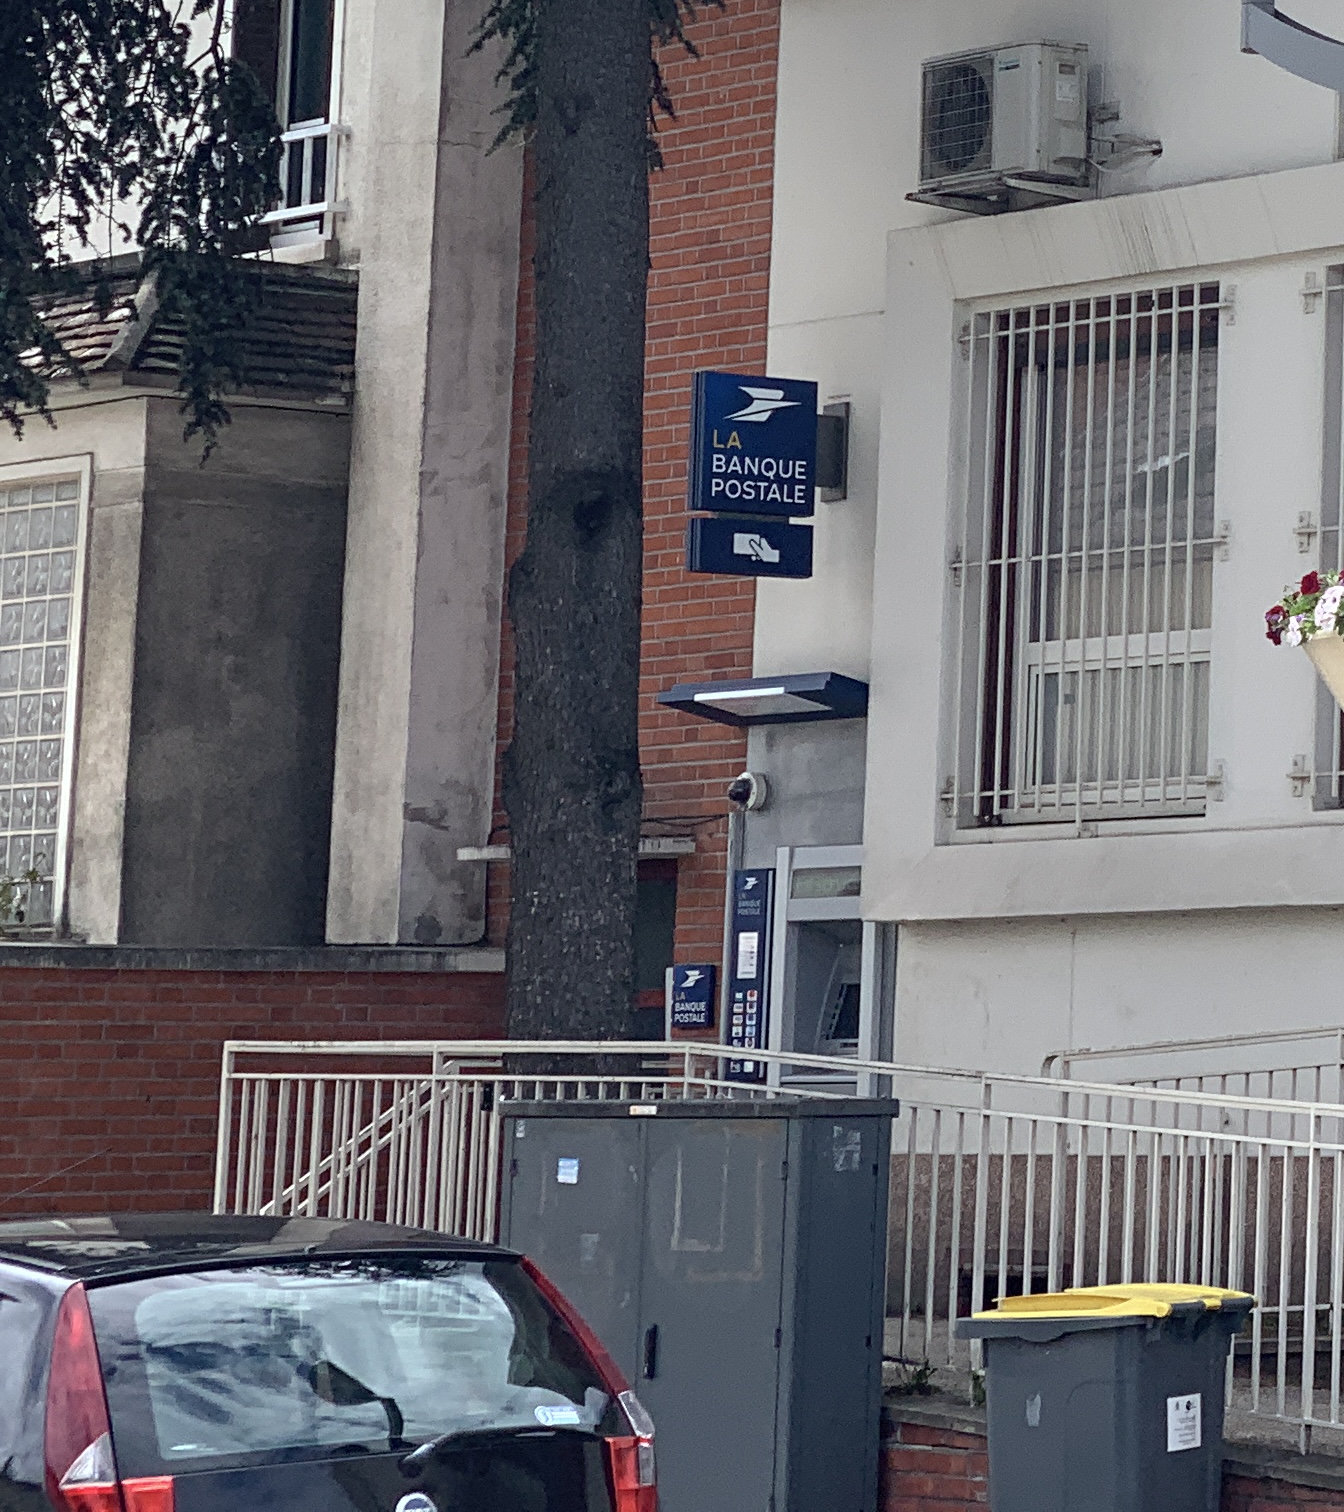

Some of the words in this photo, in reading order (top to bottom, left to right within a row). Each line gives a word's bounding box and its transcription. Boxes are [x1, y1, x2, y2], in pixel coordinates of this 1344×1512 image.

[712, 429, 742, 450] LA
[711, 454, 807, 481] BANQUE
[711, 479, 806, 504] POSTALE
[675, 991, 686, 1001] LA
[674, 1001, 706, 1013] BANQUE
[673, 1012, 706, 1023] POSTALE
